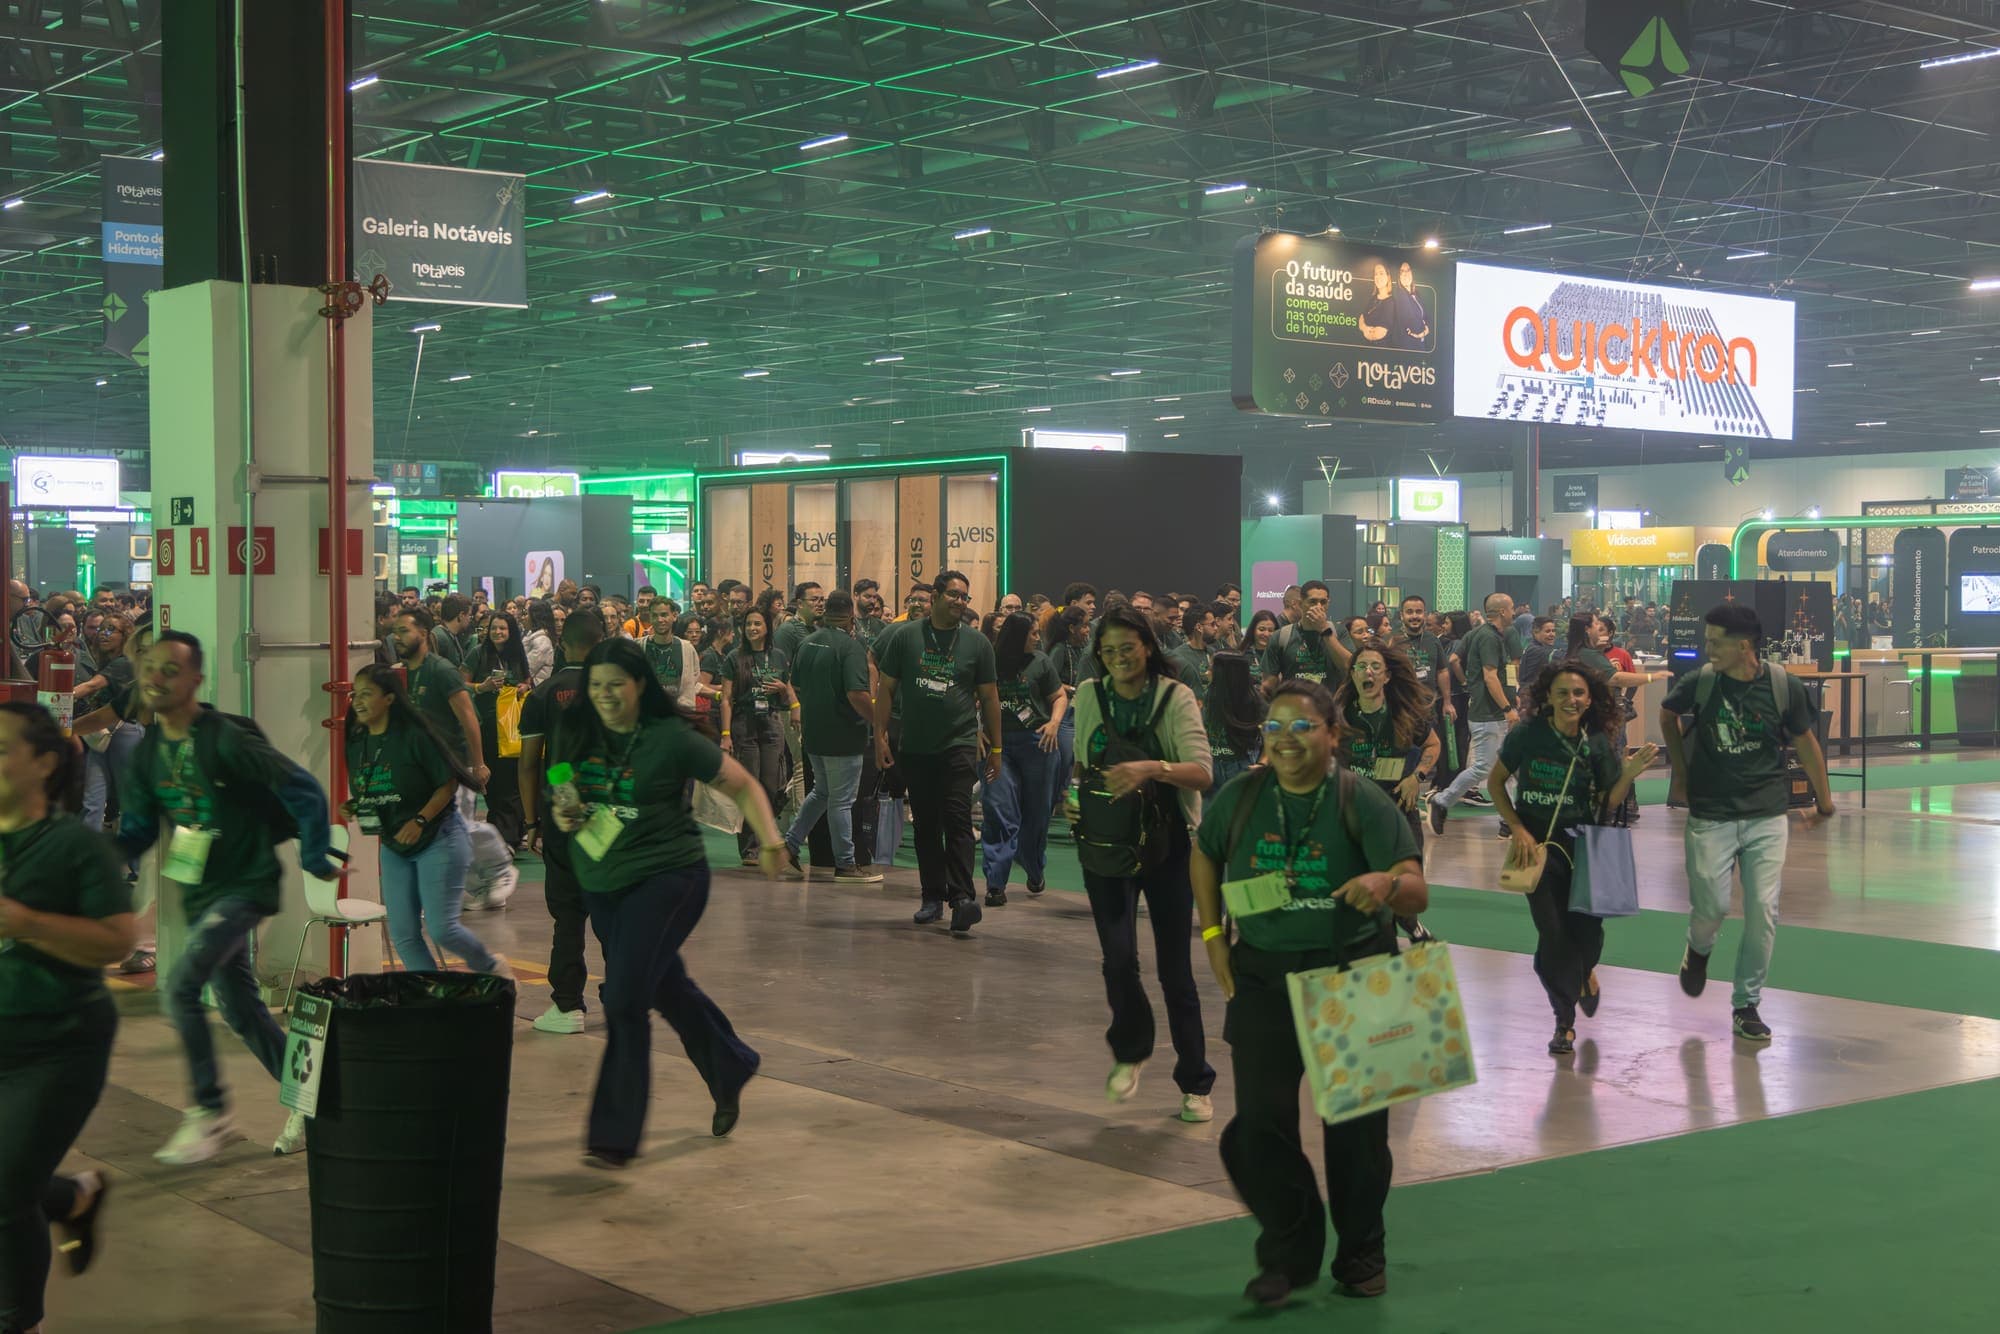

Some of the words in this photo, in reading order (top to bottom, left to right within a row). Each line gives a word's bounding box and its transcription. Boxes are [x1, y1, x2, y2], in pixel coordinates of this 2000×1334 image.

[115, 231, 149, 242] Ponto
[362, 217, 429, 238] Galeria
[433, 223, 513, 245] Notáveis
[1286, 260, 1299, 278] O
[1303, 262, 1352, 284] futuro
[1286, 277, 1304, 297] da
[1308, 280, 1353, 301] saúde
[1286, 298, 1329, 313] começa
[1286, 309, 1304, 321] nas
[1307, 313, 1357, 328] conexões
[1286, 321, 1300, 333] de
[1302, 323, 1328, 339] hoje.
[1503, 306, 1757, 387] Quicktron
[1607, 534, 1657, 547] Videocast
[1778, 549, 1828, 558] Atendimento
[1914, 550, 1922, 620] Relacionamento
